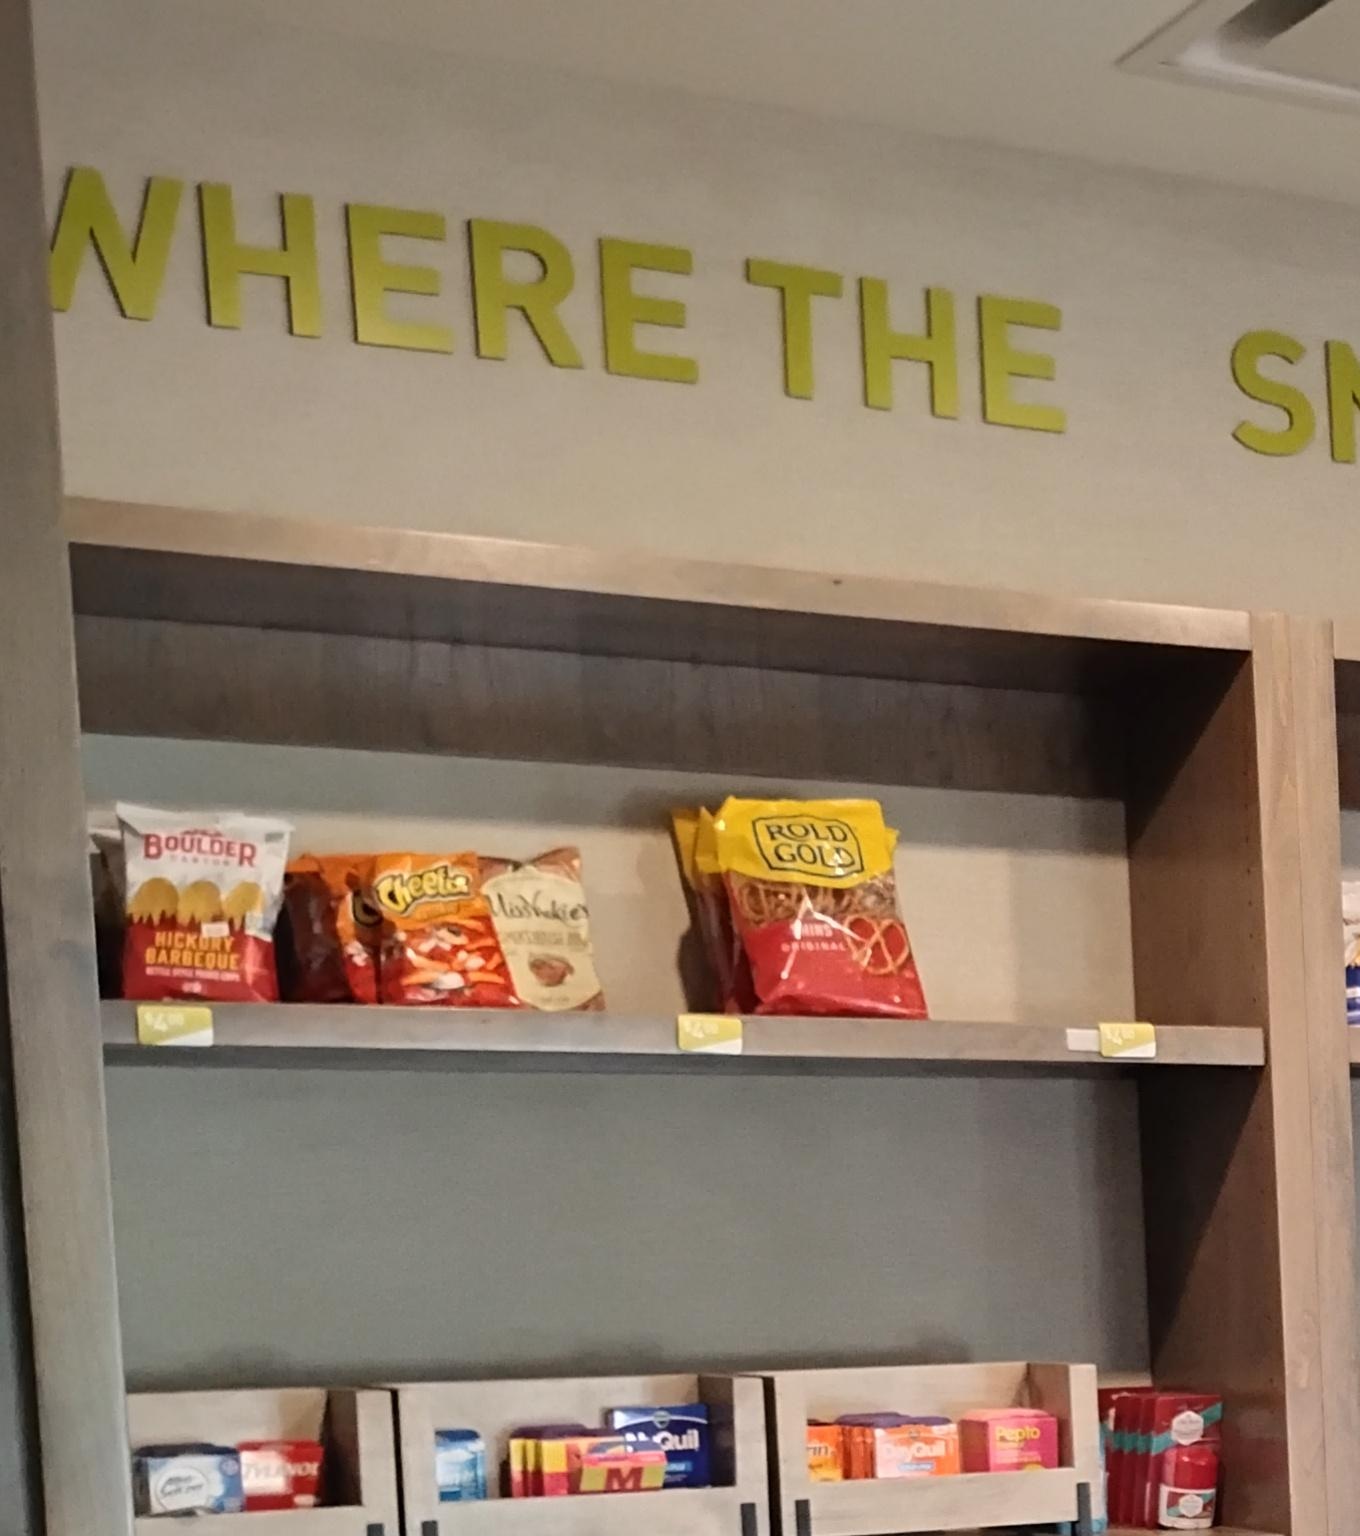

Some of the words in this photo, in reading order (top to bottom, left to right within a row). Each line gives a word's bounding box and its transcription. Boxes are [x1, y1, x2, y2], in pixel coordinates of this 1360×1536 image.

[50, 166, 699, 383] WHERE
[745, 257, 1067, 433] THE
[766, 823, 848, 842] ROLD
[143, 831, 258, 868] BOULDER
[774, 844, 856, 868] GOLD
[145, 946, 241, 972] BARBEQUE
[995, 1427, 1040, 1444] Pepto
